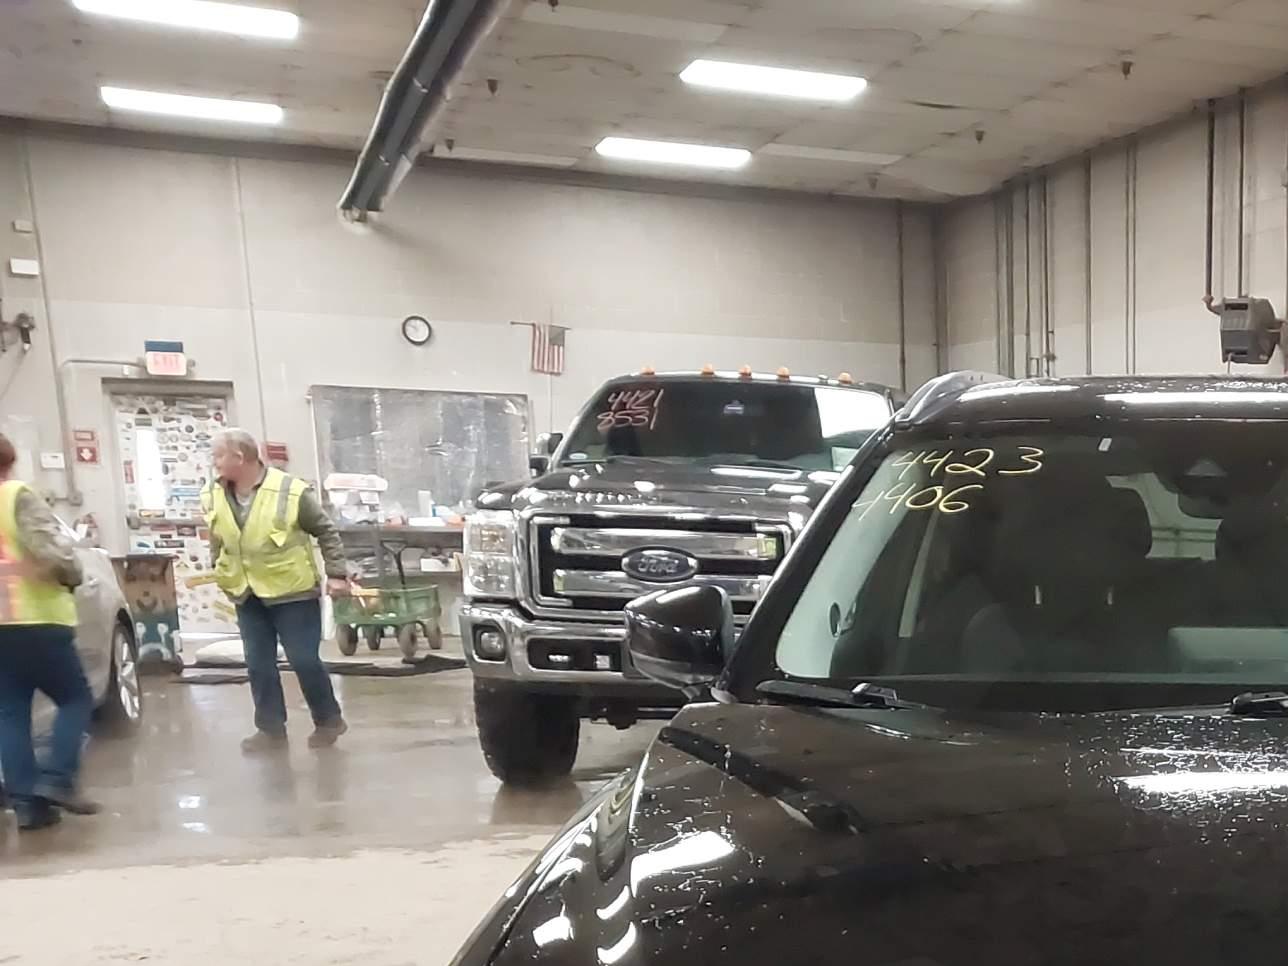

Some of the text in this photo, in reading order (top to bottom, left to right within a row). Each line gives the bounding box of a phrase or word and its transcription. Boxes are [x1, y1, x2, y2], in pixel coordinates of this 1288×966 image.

[608, 388, 664, 410] 4421
[597, 408, 658, 431] 8531
[891, 446, 1044, 480] 4423
